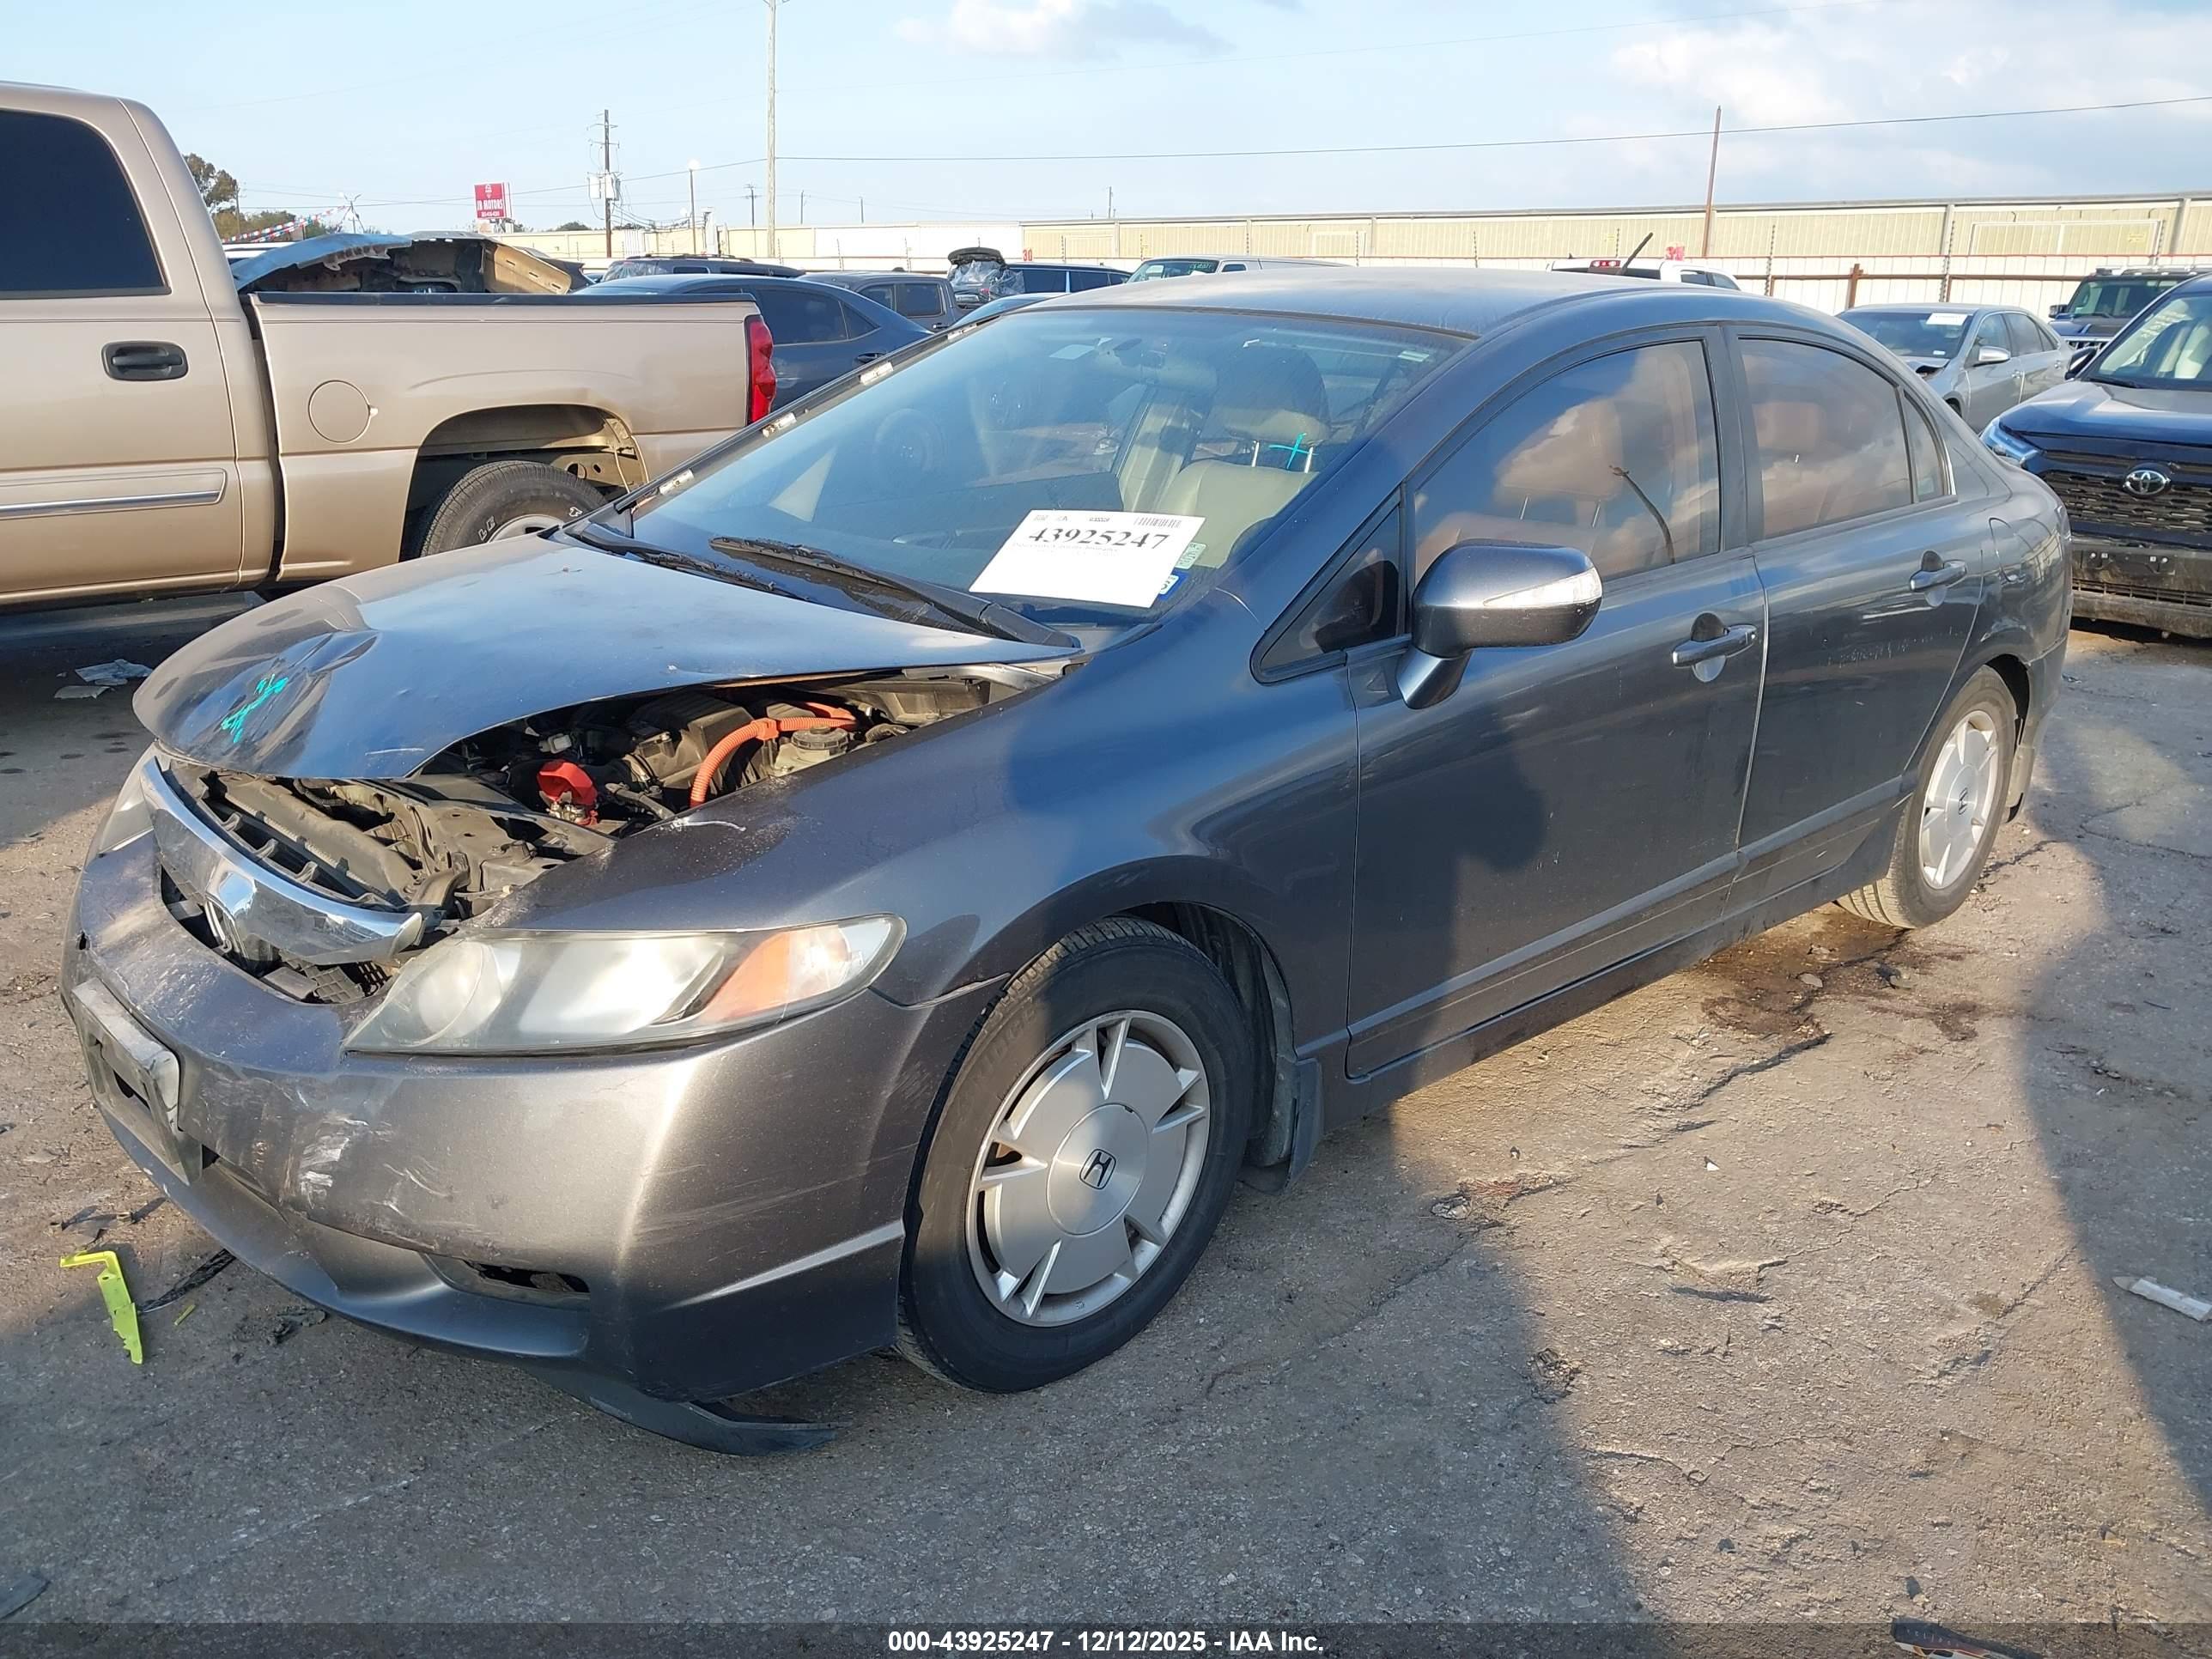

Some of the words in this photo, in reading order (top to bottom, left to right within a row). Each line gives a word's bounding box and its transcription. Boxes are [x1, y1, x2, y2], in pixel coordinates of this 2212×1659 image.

[483, 198, 503, 210] MOTORS
[1023, 249, 1033, 262] 30
[1029, 527, 1170, 549] 43925247
